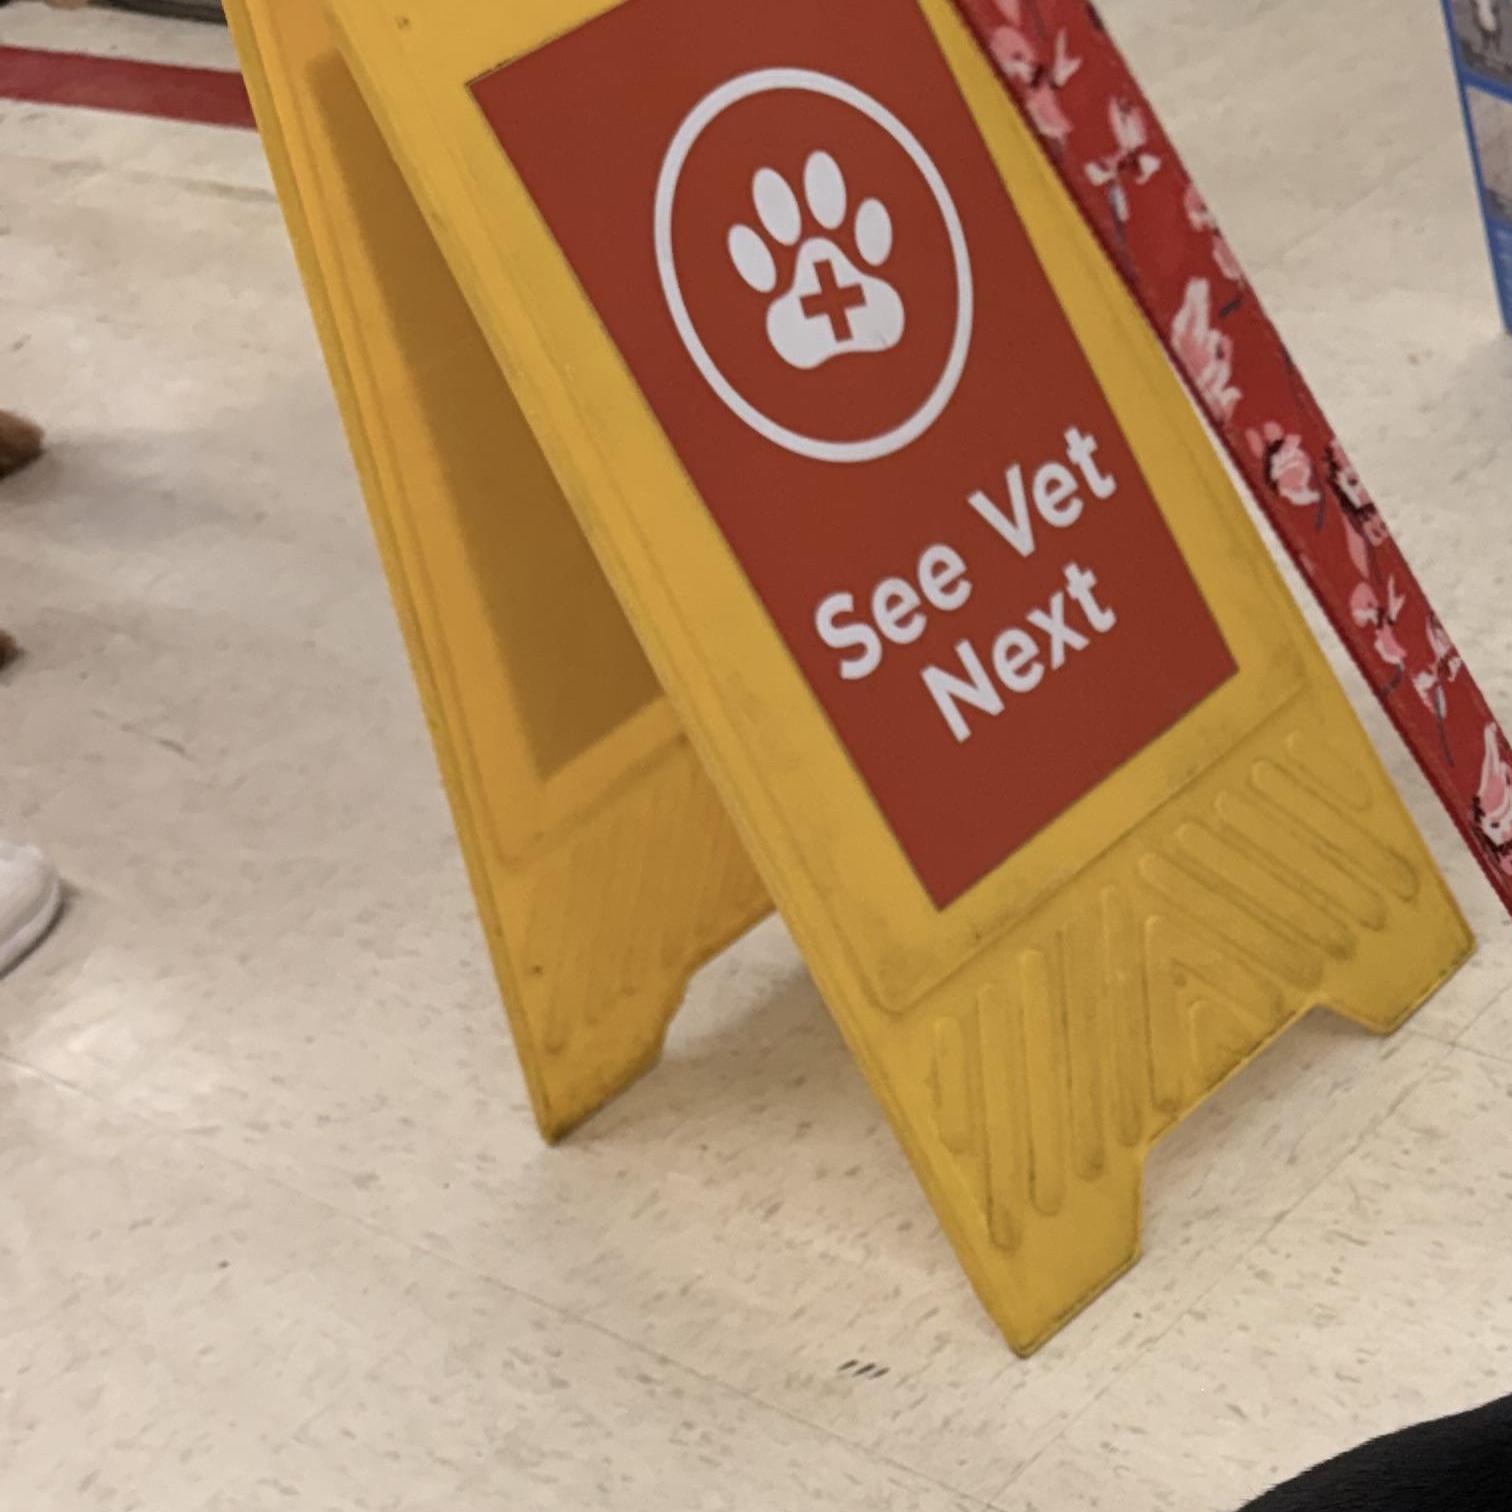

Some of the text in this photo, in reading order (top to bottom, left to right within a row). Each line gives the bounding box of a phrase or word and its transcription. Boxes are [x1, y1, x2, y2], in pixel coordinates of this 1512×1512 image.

[815, 426, 1117, 680] See Vet
[920, 562, 1117, 744] Next
